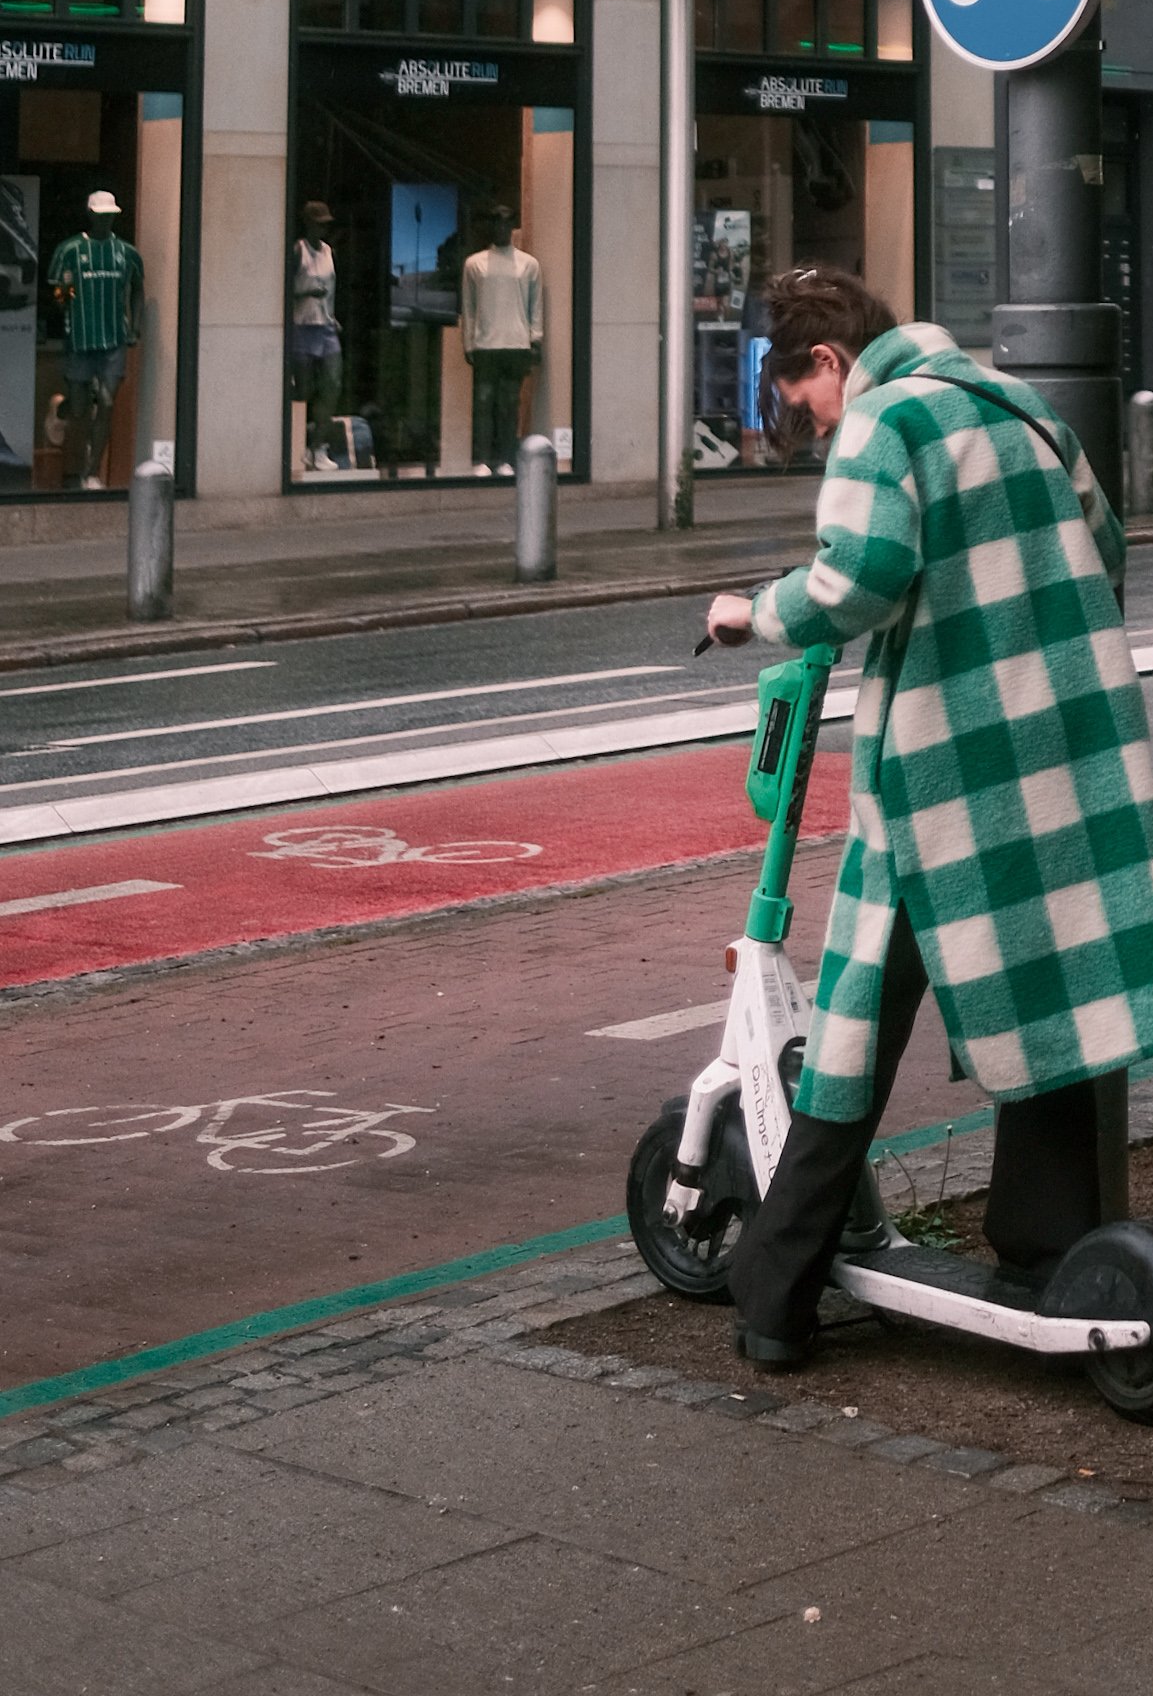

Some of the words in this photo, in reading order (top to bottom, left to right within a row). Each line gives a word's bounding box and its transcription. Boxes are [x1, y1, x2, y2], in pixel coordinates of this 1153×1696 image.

[397, 79, 449, 96] BREMEN
[760, 94, 806, 111] BREMEN
[755, 1097, 769, 1146] Lime
